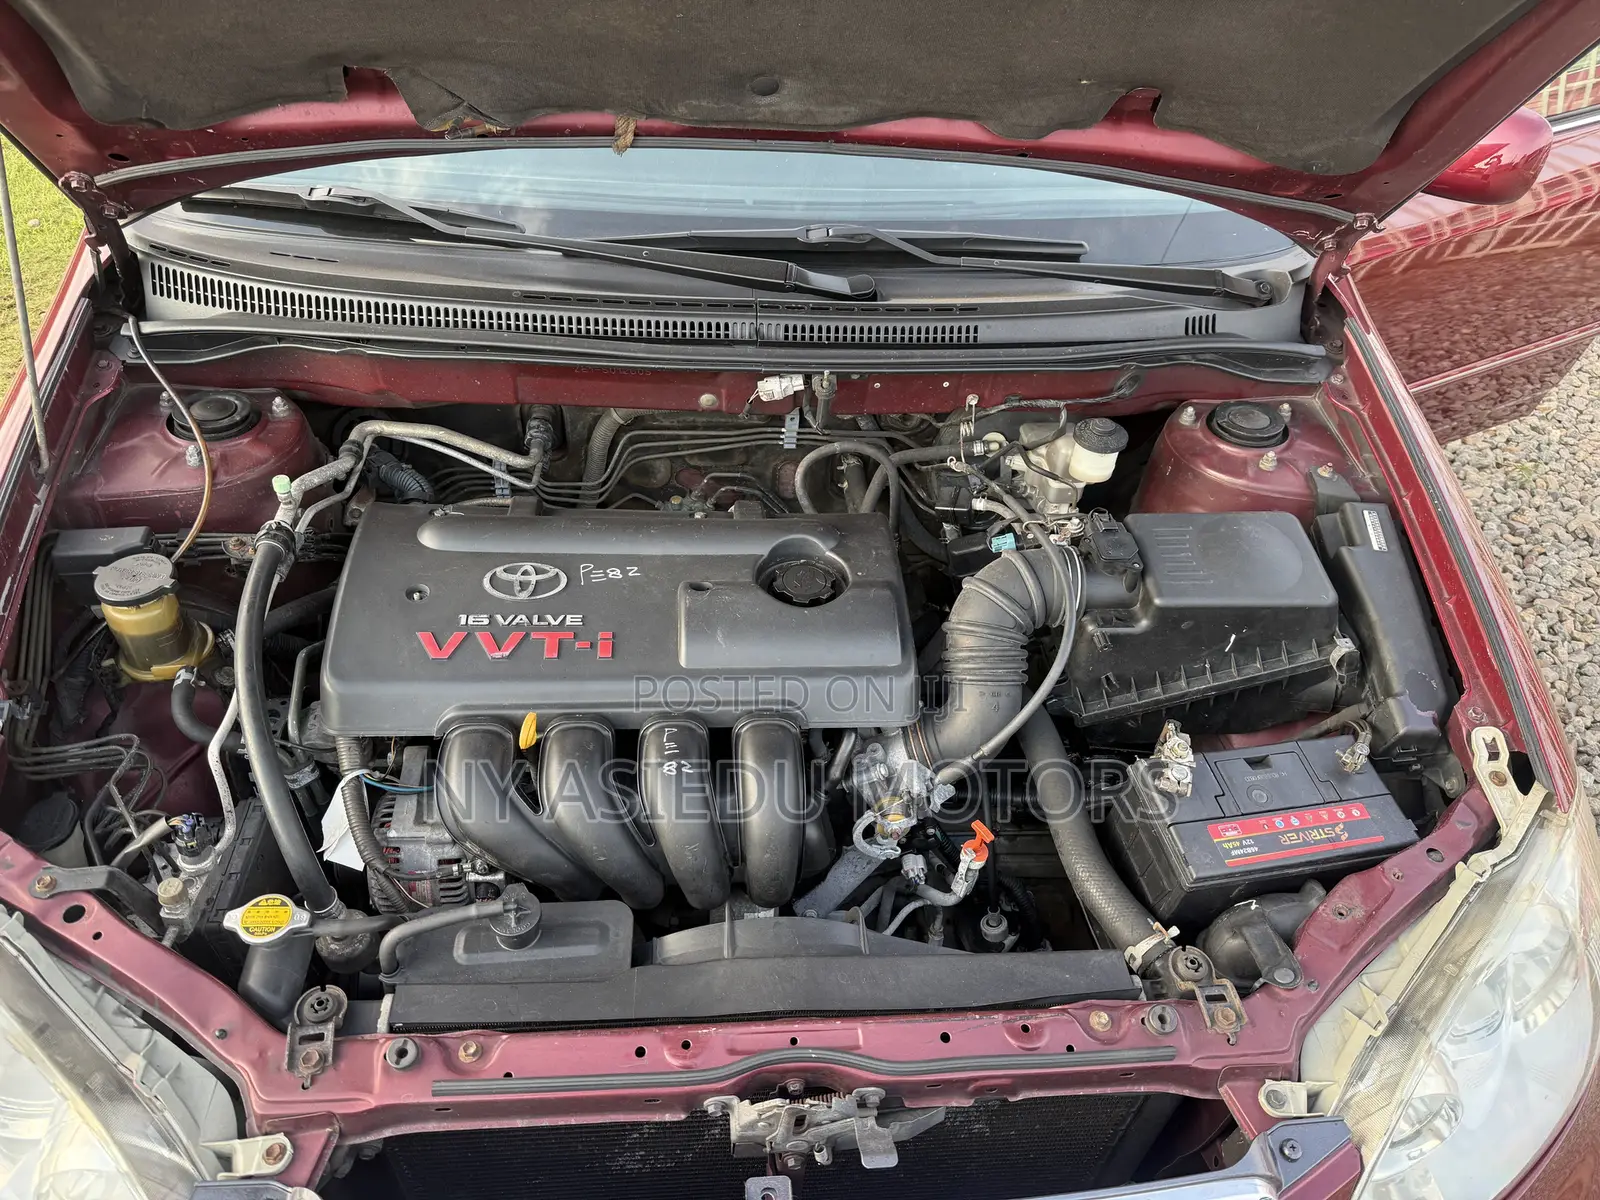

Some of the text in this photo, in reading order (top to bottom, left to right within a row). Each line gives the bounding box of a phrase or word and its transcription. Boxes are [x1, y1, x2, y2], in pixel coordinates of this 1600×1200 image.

[457, 614, 584, 626] 16 VALVE
[415, 631, 614, 661] VVT-i
